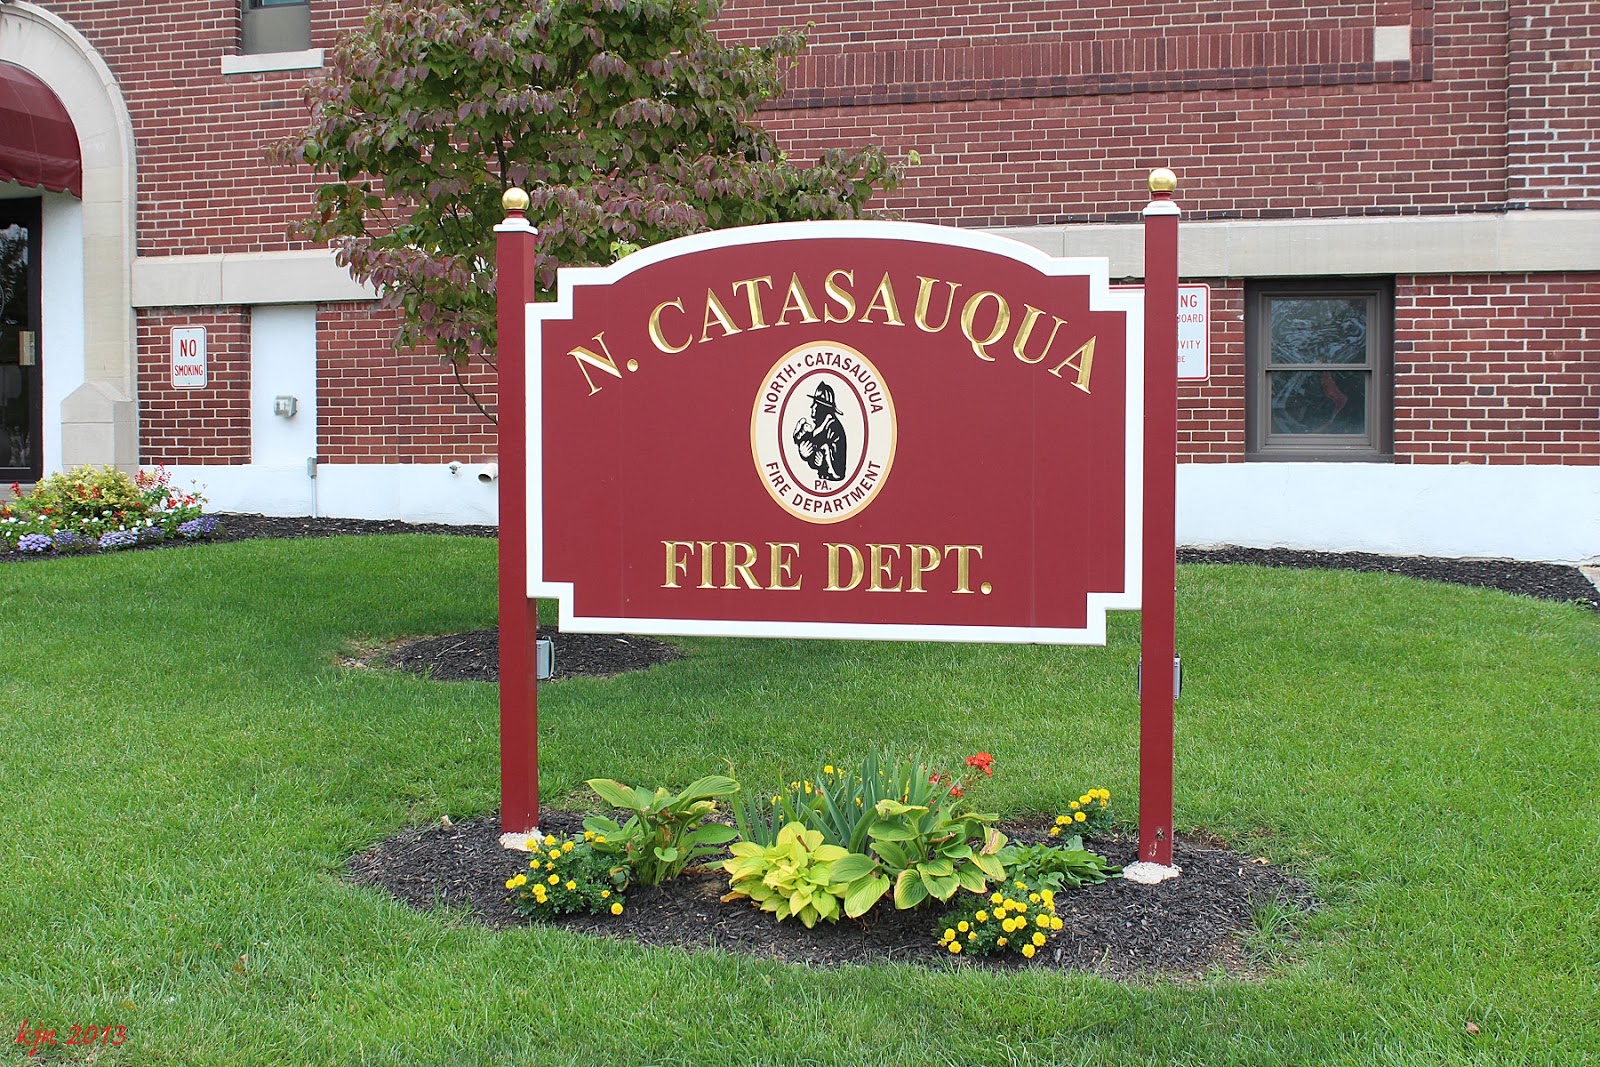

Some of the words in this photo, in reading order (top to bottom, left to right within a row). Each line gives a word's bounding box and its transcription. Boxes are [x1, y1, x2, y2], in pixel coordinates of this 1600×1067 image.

[180, 339, 197, 357] NO
[566, 331, 639, 397] N.
[648, 269, 1097, 395] CATASAUQUA
[174, 364, 204, 376] SMOKING
[804, 352, 884, 414] CATASAUQUA
[766, 461, 792, 497] FIRE
[791, 460, 881, 513] DEPARTMENT
[814, 480, 832, 490] PA.
[660, 540, 803, 591] FIRE
[822, 542, 993, 596] DEPT.
